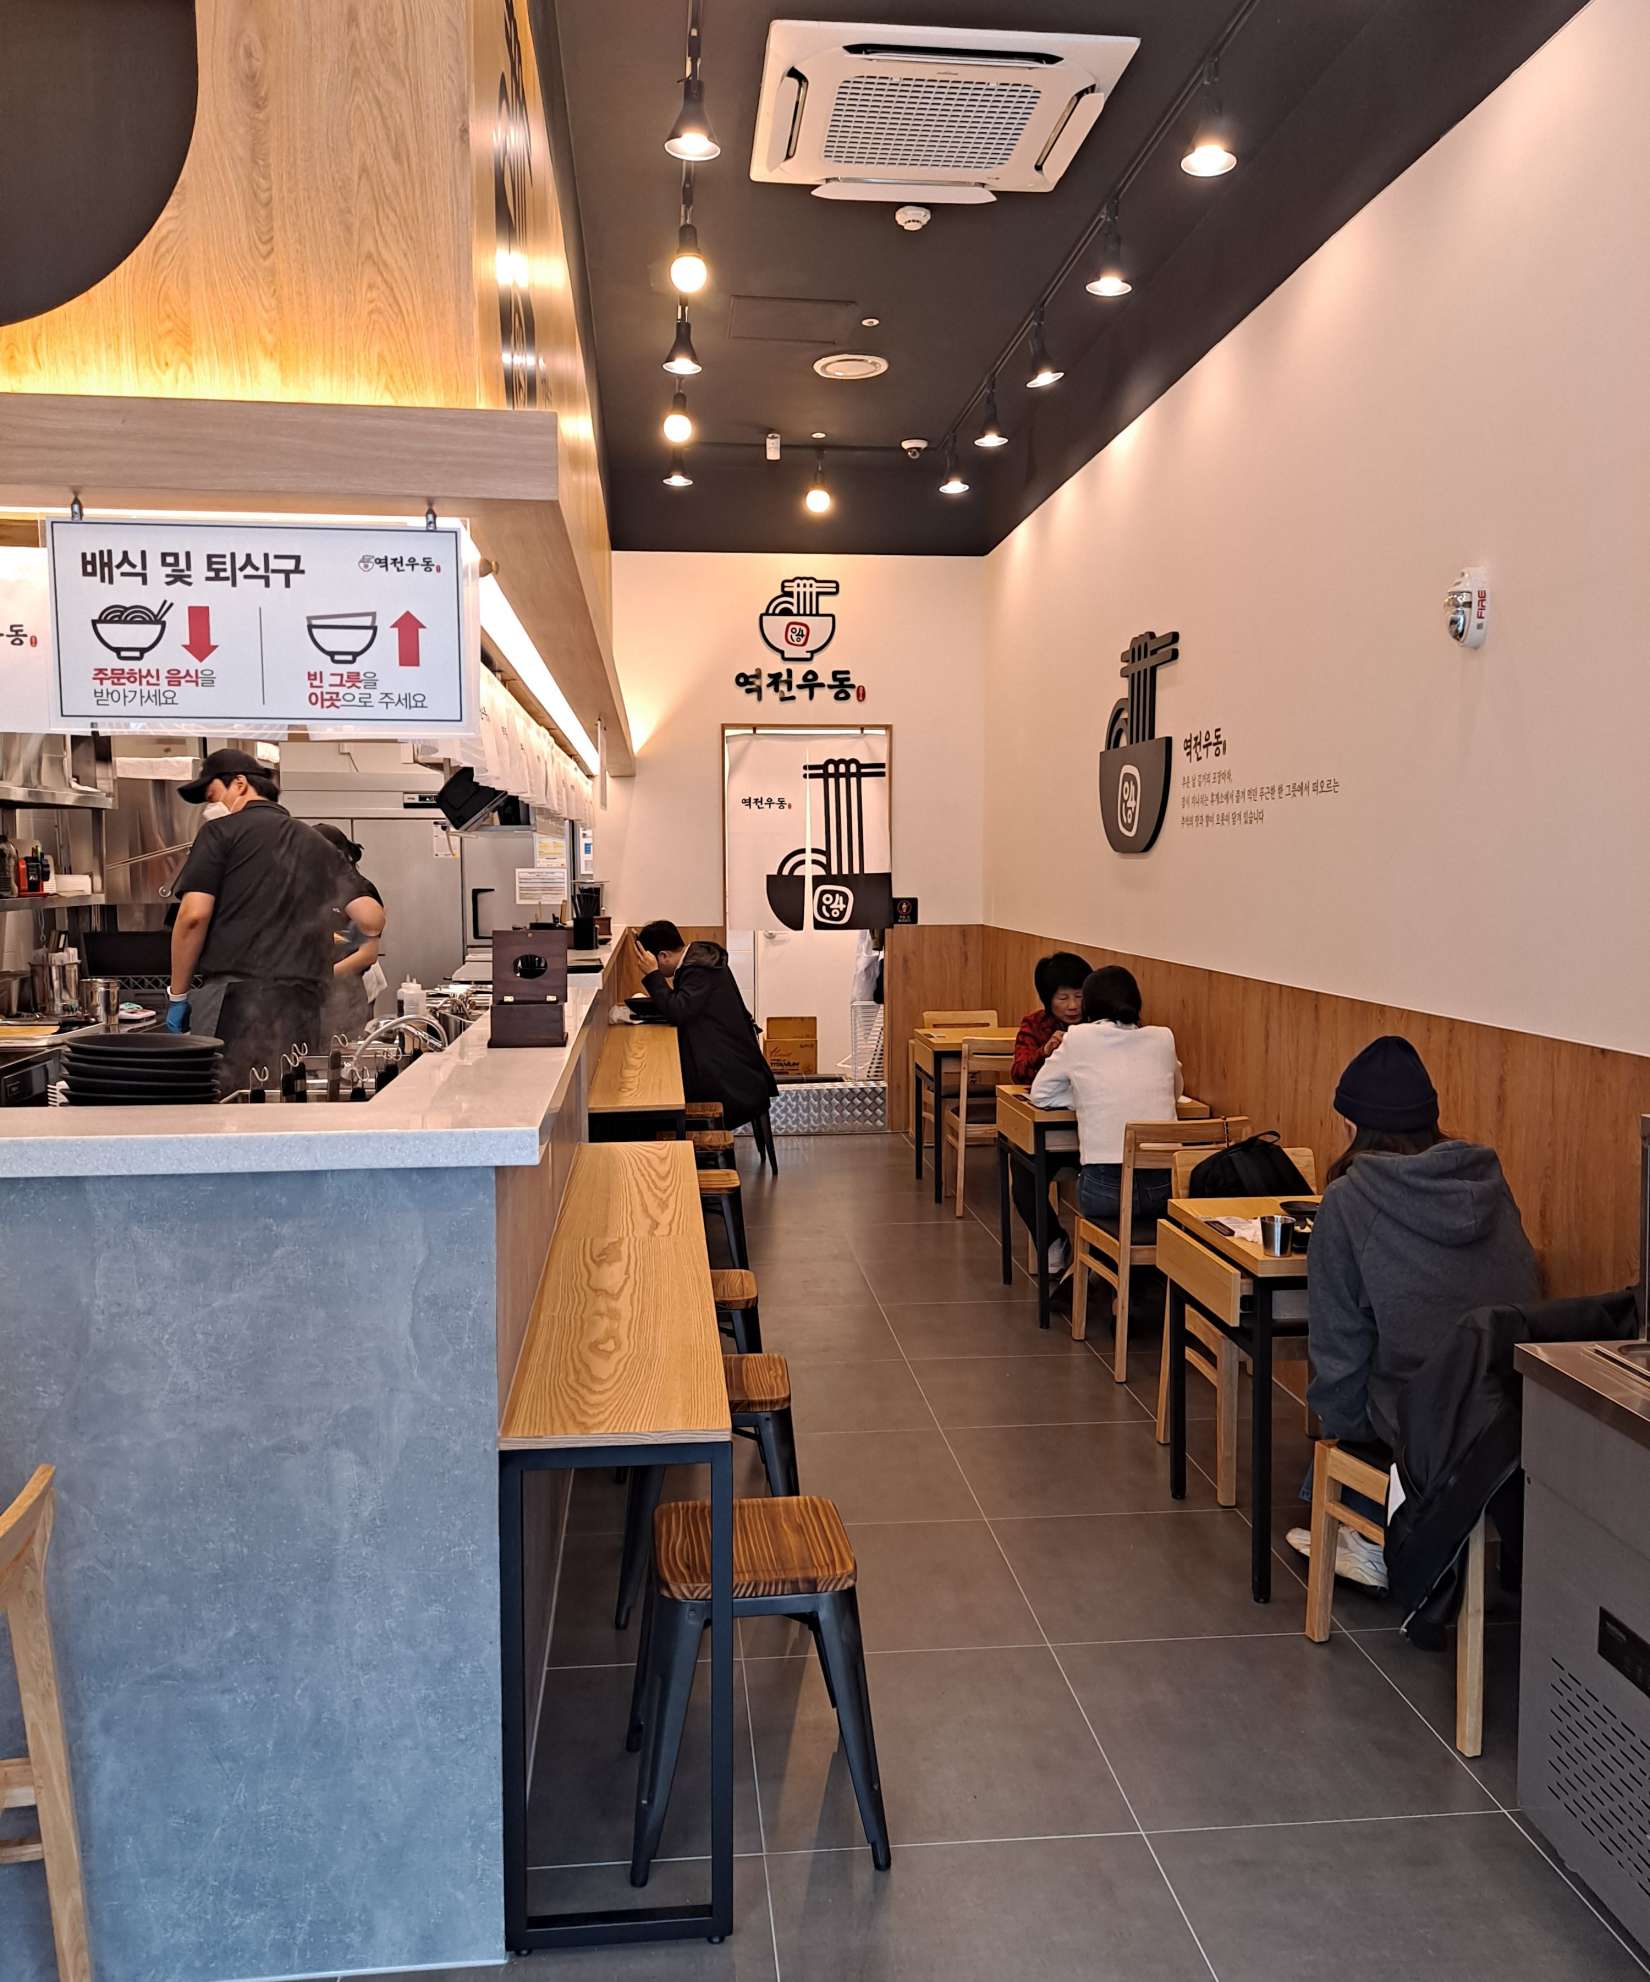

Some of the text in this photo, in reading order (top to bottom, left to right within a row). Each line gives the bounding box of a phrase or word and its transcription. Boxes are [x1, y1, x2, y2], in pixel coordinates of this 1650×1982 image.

[81, 549, 306, 588] 배식 및 퇴식구
[374, 555, 436, 573] 역전우동
[92, 668, 216, 687] 주문하신 음식을
[307, 671, 379, 689] 빈 그릇을
[735, 668, 856, 702] 역전우동
[93, 688, 179, 706] 받아가세요
[308, 691, 428, 709] 이곳으로 주세요
[1183, 728, 1223, 763] 역전우동
[741, 796, 787, 810] 역전우동
